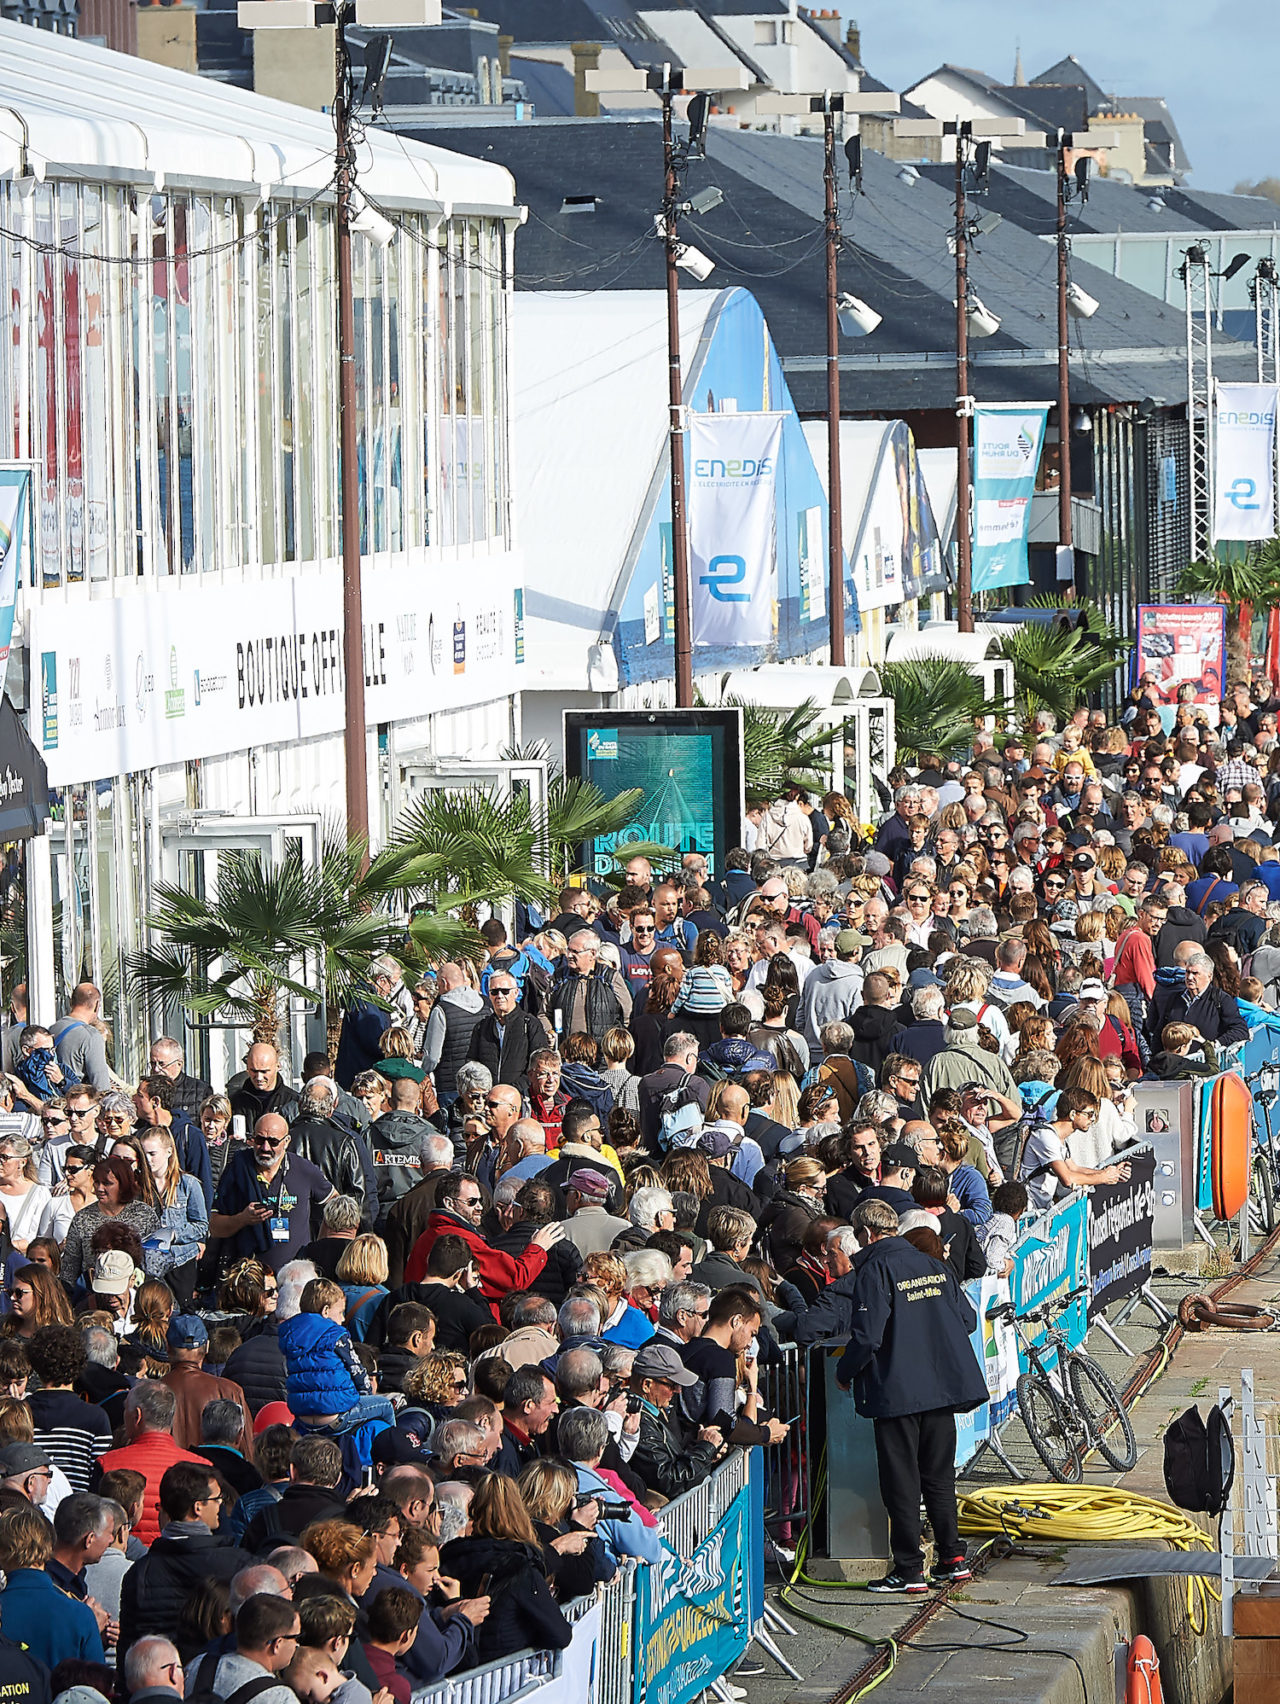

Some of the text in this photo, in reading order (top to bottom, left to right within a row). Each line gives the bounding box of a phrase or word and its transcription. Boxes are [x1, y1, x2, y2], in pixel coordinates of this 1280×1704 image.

[236, 633, 308, 709] BOUTIQUE
[312, 623, 386, 697] OFFILLE
[376, 1151, 421, 1165] ARTEMIS
[0, 1682, 30, 1698] ATION
